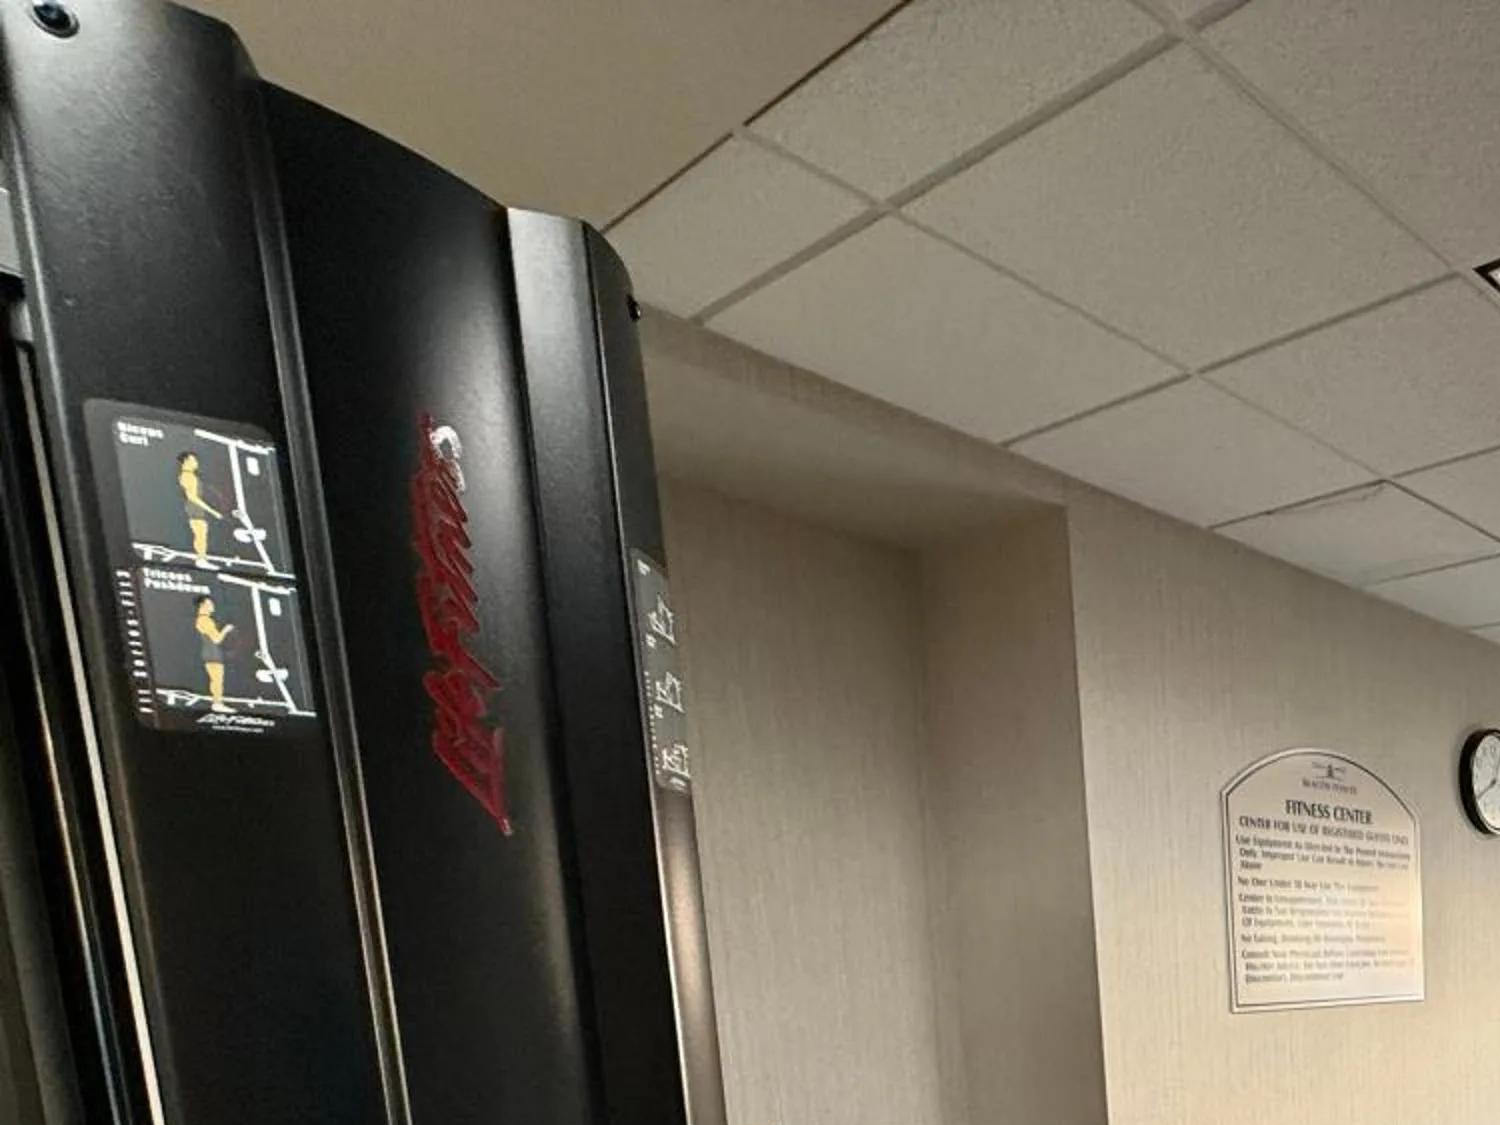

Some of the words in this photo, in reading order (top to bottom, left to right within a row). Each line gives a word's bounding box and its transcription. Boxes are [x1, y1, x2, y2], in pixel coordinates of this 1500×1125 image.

[1285, 799, 1330, 819] FITNESS
[1333, 804, 1373, 825] CENTER
[1239, 815, 1271, 830] CENTER
[1273, 819, 1290, 832] FOR
